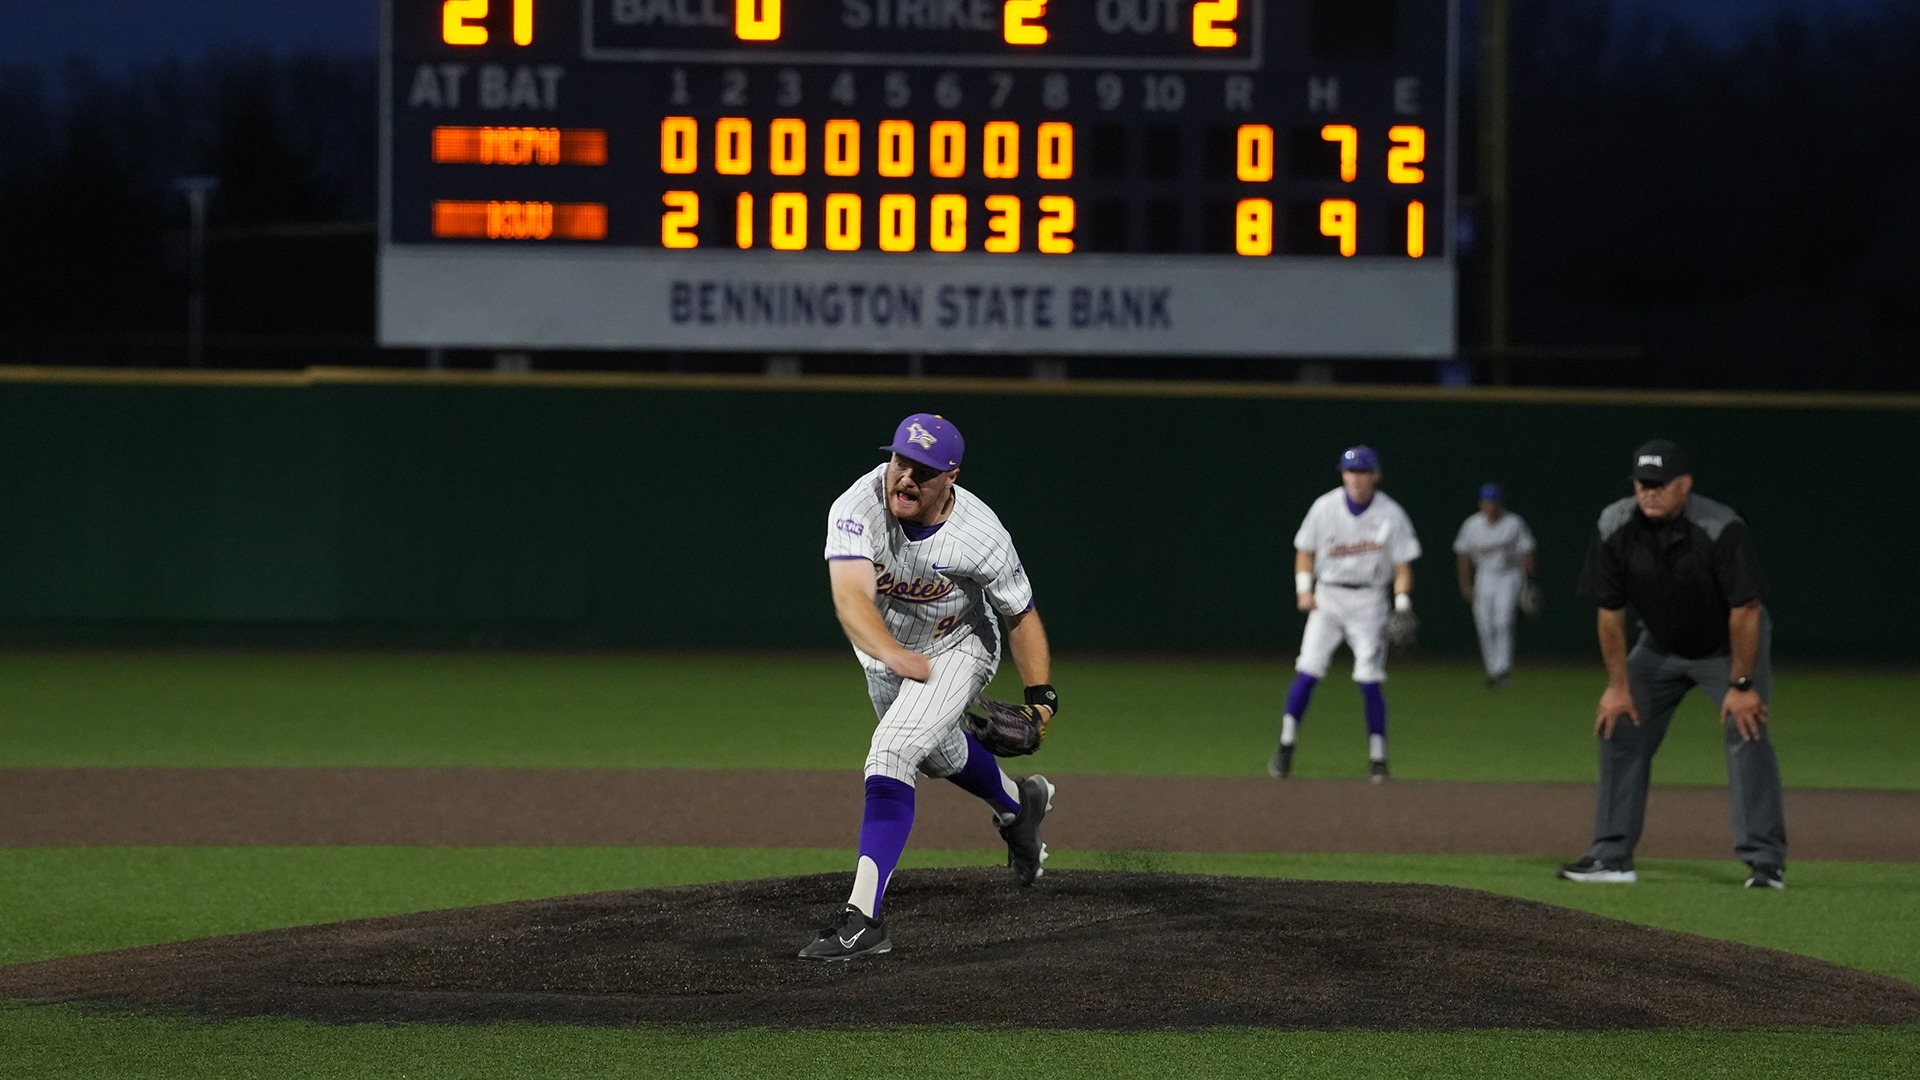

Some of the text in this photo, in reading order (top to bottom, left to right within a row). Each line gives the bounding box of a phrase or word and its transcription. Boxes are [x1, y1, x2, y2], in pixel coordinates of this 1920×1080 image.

[408, 65, 564, 111] AT BAT
[670, 69, 1420, 114] 1 2 3 4 5 6 7 8 9 10 R H E
[661, 116, 1425, 184] 0 0 0 0 0 0 0 0 0 7 2
[661, 190, 1424, 258] 2 1 0 0 0 0 3 2 8 9 1
[669, 280, 1173, 331] BENNINGTON STATE BANK
